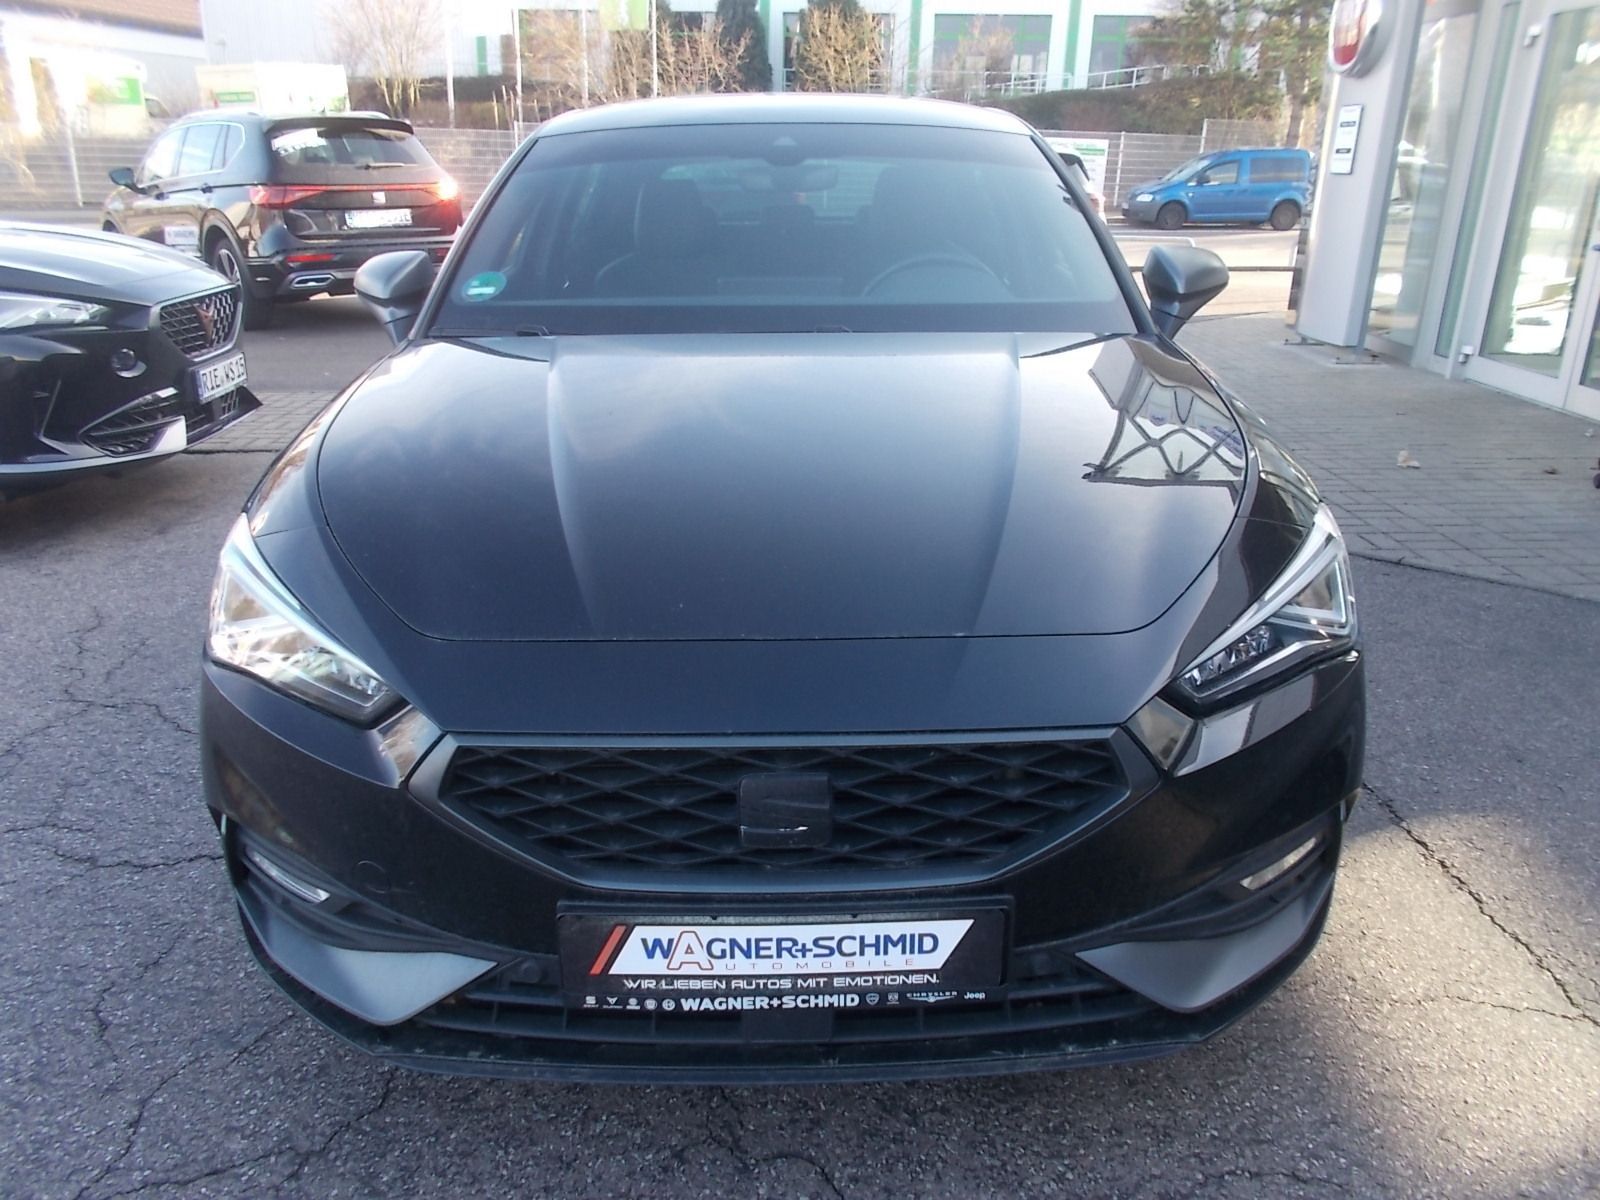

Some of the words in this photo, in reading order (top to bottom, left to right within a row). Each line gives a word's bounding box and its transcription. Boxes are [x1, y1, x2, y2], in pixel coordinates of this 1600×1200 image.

[640, 930, 939, 970] WAGNER+SCHMID
[624, 979, 656, 989] WIR
[662, 979, 726, 990] LIEBEN
[731, 979, 792, 989] AUTOS
[797, 978, 827, 988] MIT
[833, 974, 940, 987] EMOTIONEN.
[681, 994, 860, 1011] WAGNER+SCHMID
[964, 992, 986, 1000] Jeep
